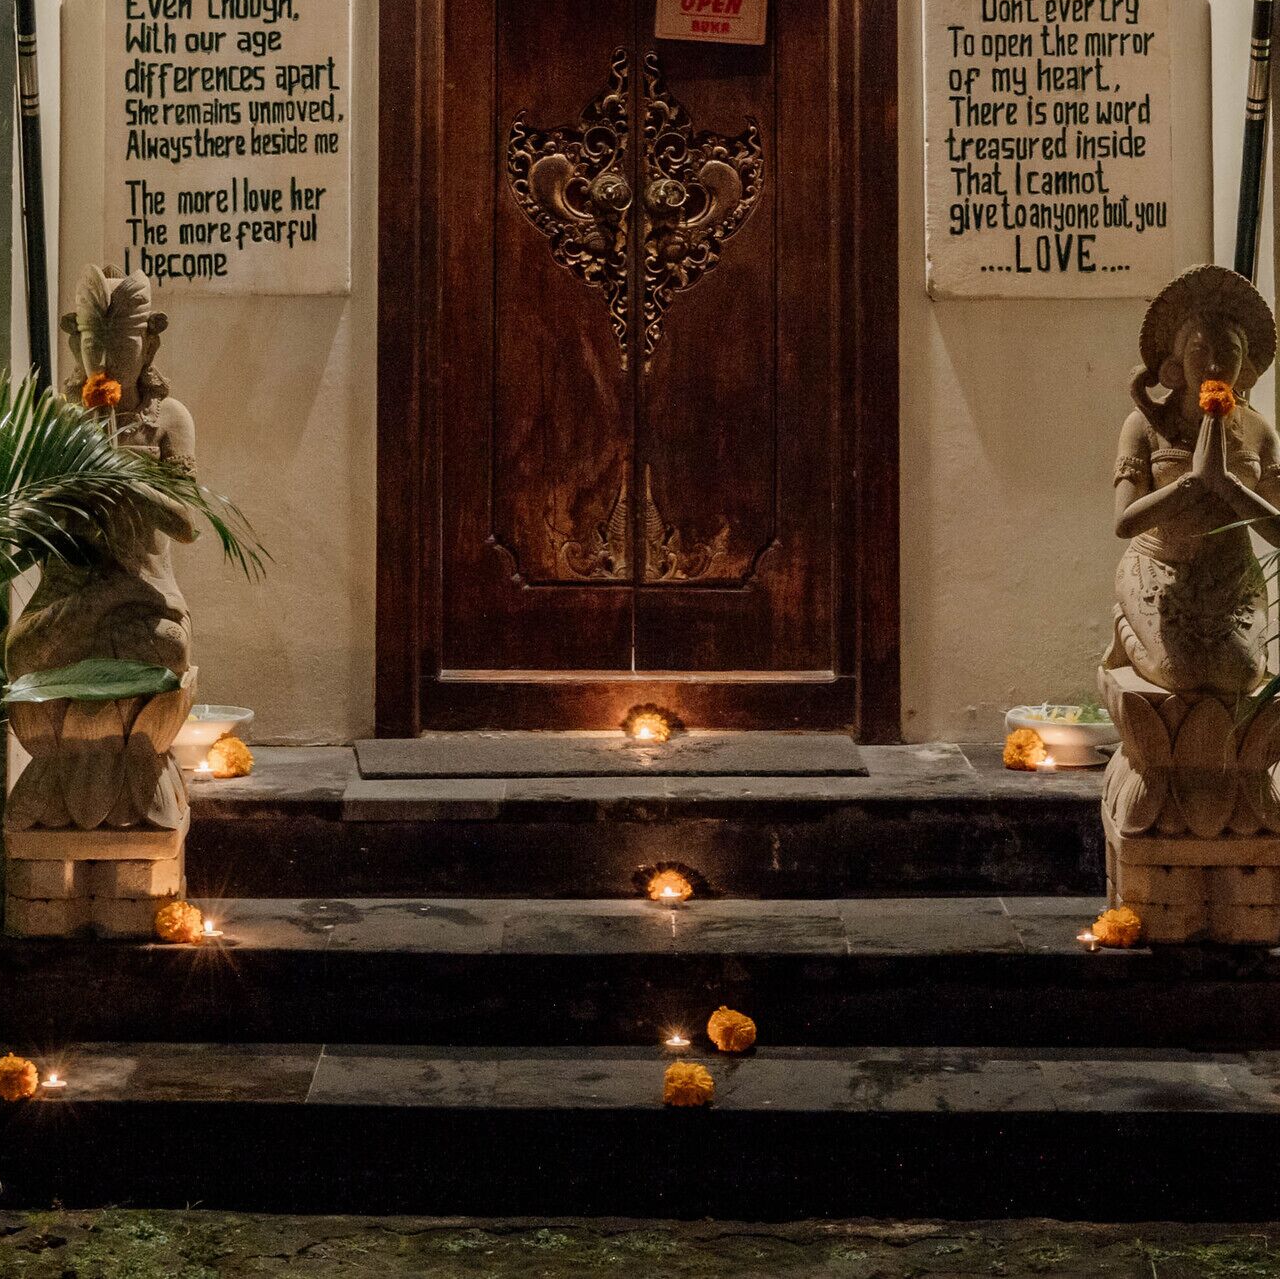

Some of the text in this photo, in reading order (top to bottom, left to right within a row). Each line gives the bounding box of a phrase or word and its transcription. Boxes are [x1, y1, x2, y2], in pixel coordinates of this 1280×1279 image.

[125, 22, 282, 56] With our age
[947, 24, 1155, 61] To open the mirror
[125, 57, 340, 99] differences apart
[949, 58, 1121, 95] of my heart,
[125, 93, 344, 126] She remains unmoved,
[948, 93, 1150, 127] There is one word
[126, 126, 339, 164] Always there beside me
[945, 125, 1146, 161] treasured inside
[125, 176, 326, 215] The more I love her
[951, 161, 1109, 195] That I cannot
[126, 214, 317, 250] The more fearful
[950, 195, 1167, 235] give to anyone but you
[141, 248, 228, 287] become
